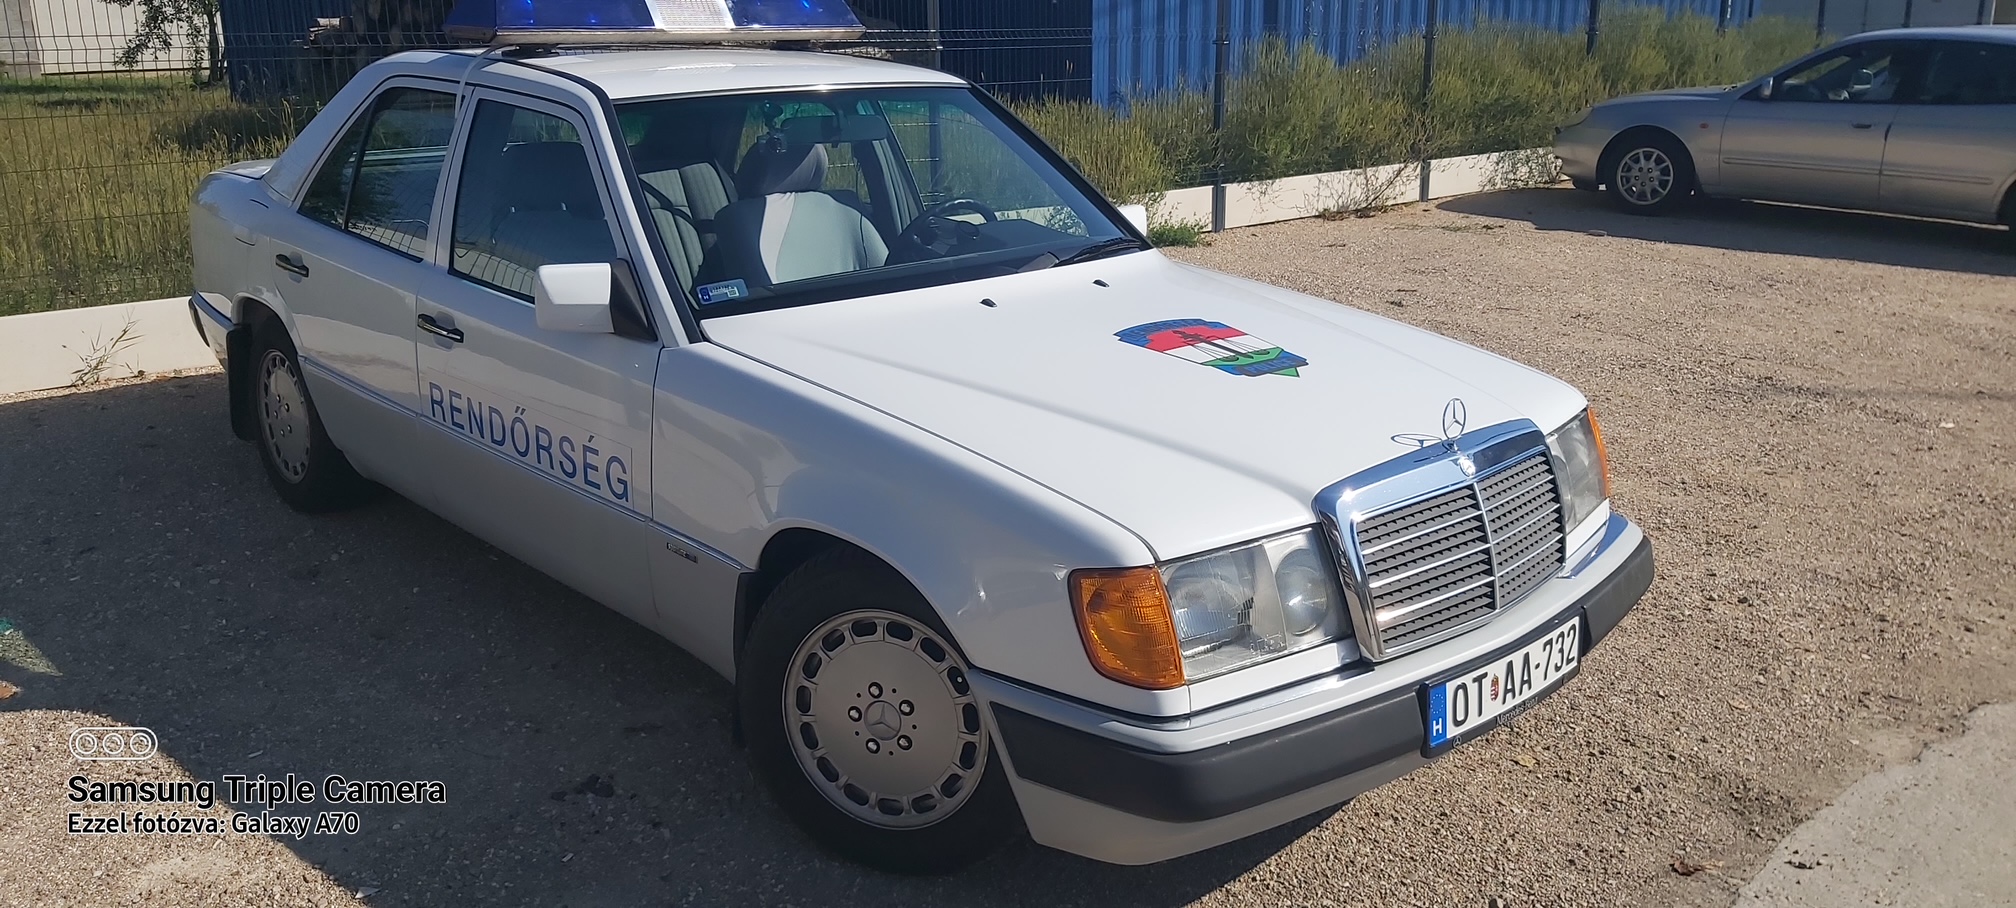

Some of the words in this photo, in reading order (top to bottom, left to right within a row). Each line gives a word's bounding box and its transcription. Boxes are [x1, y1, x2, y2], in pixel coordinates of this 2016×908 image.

[1244, 359, 1298, 373] POLICE
[429, 381, 629, 503] RENDŐRSÉG
[1452, 671, 1488, 728] OT
[1502, 623, 1577, 705] AA-732
[1432, 718, 1443, 737] H
